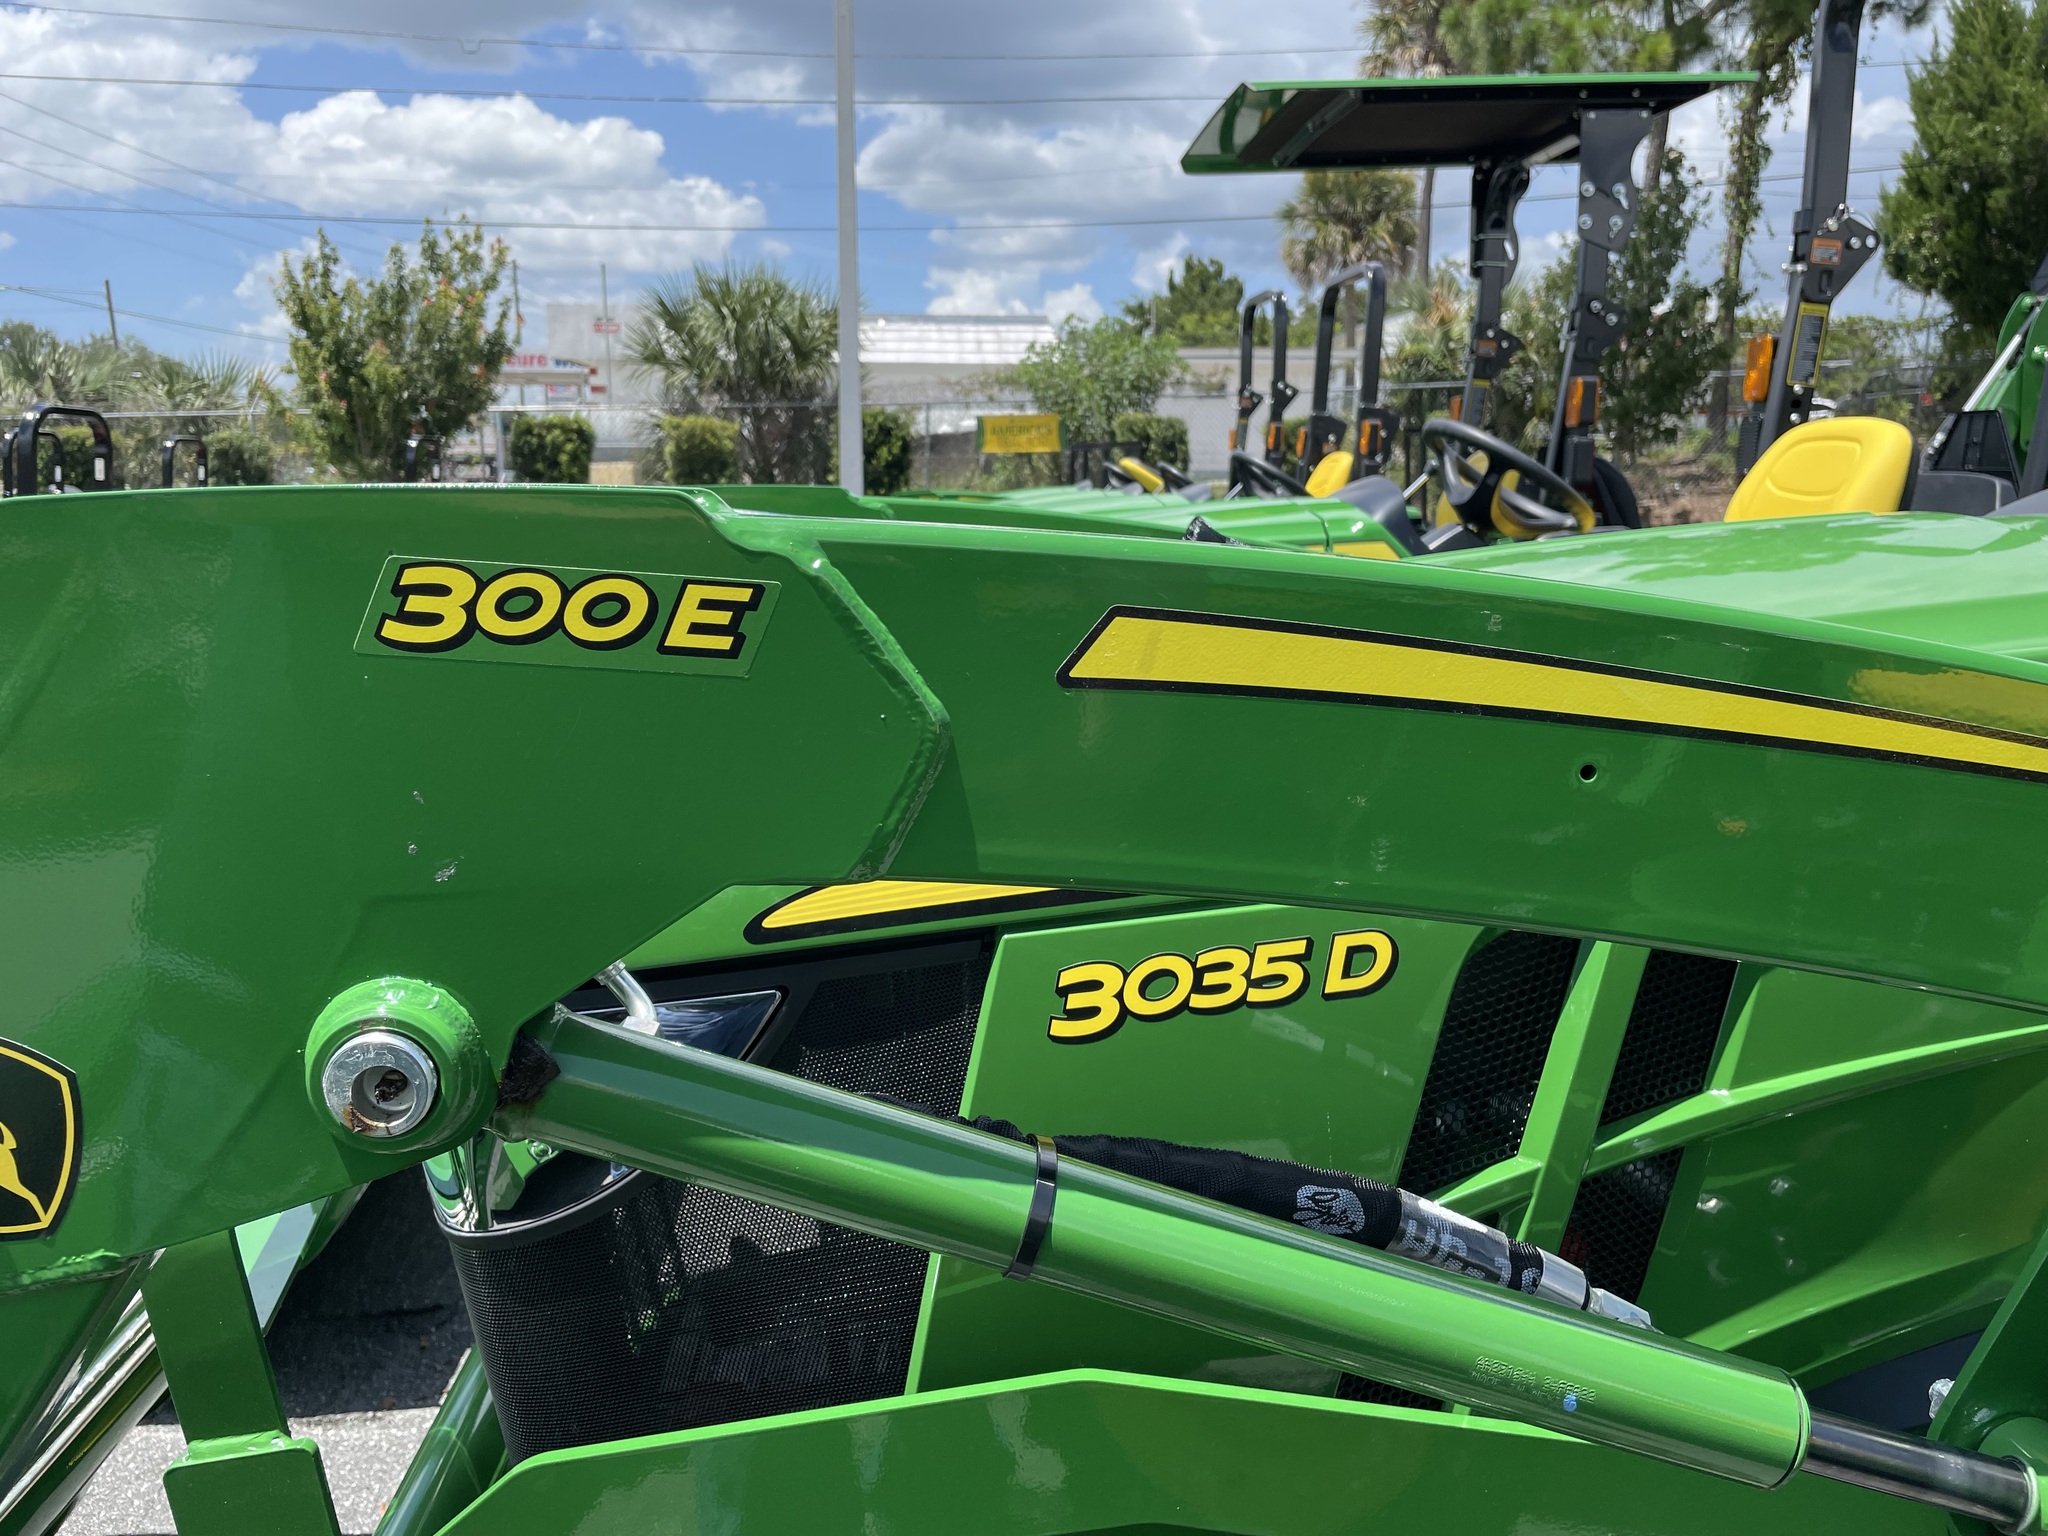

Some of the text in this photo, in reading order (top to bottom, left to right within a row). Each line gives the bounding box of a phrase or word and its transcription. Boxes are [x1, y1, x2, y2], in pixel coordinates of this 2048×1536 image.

[374, 561, 659, 653] 300
[1047, 928, 1399, 1044] 3035 D
